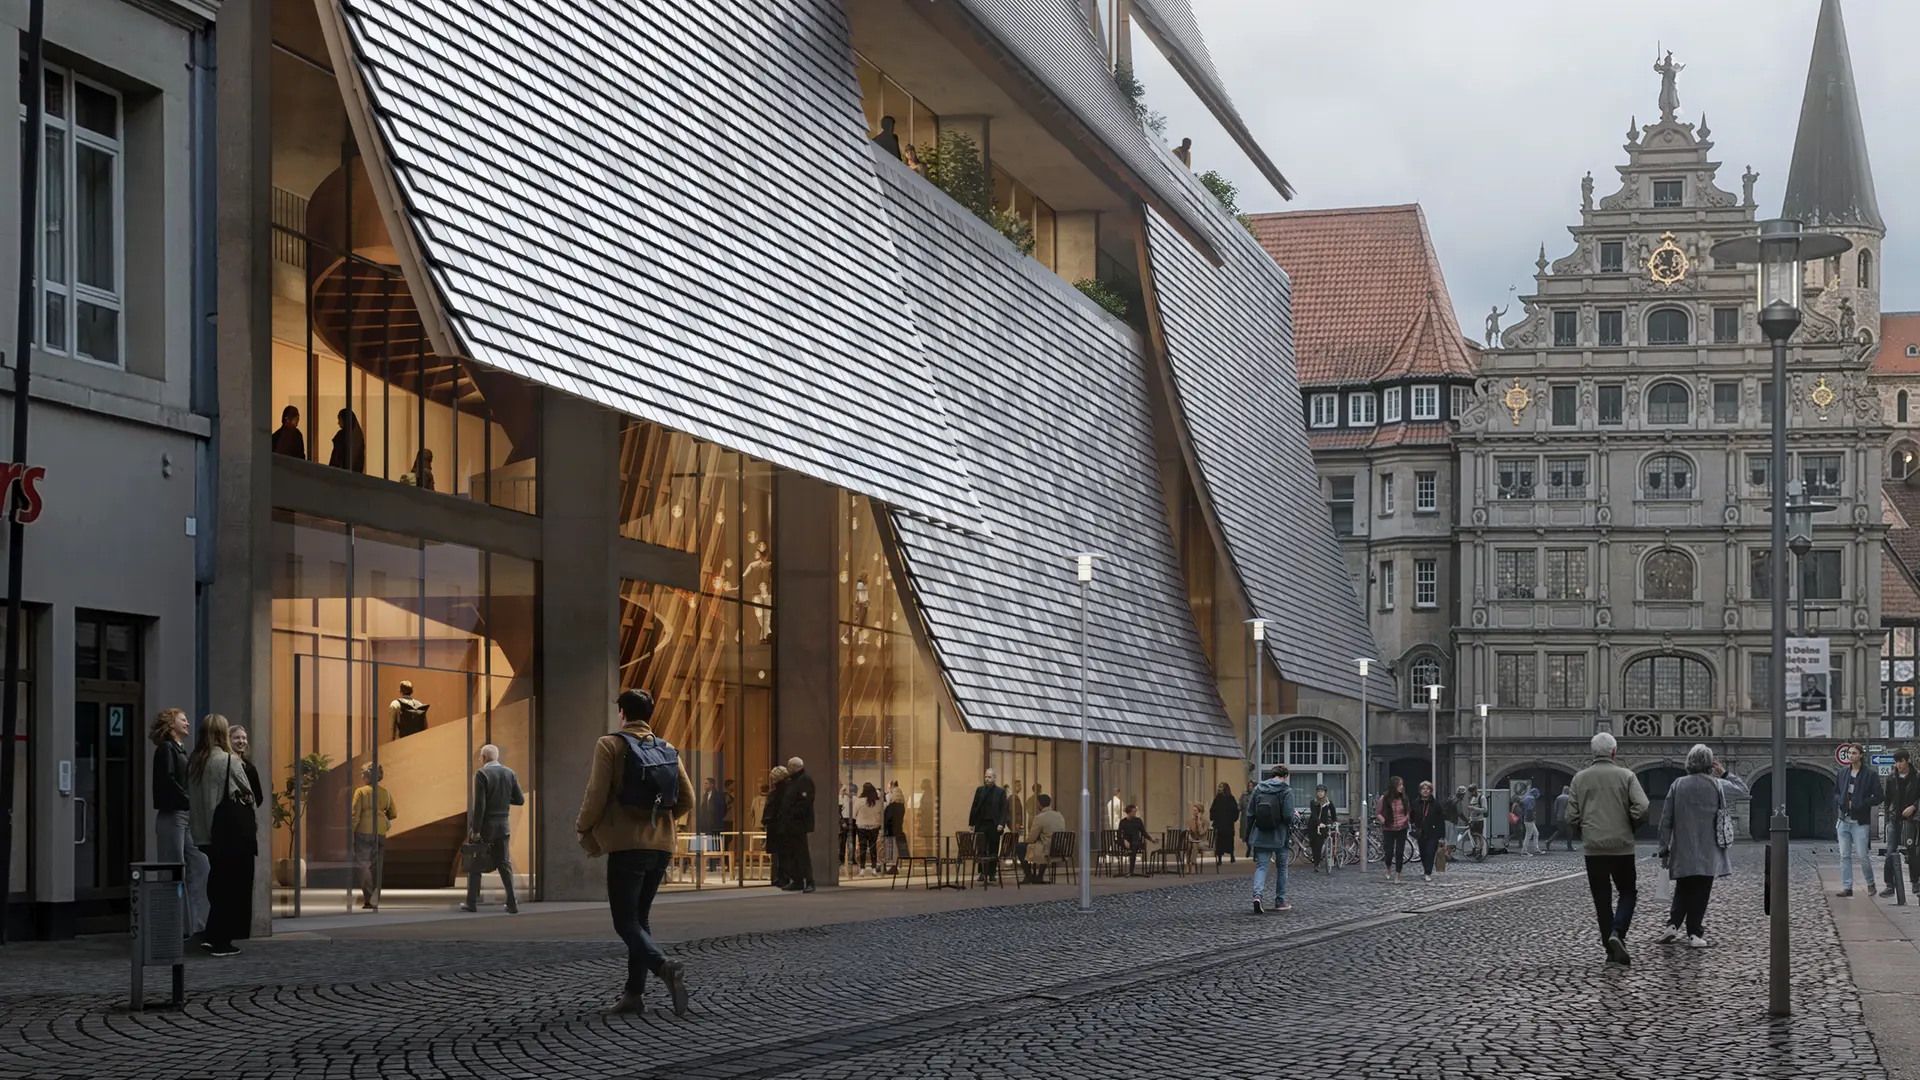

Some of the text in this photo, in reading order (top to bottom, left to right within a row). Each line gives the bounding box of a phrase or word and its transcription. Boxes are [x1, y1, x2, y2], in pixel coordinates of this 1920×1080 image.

[1793, 646, 1820, 654] Deine
[1784, 656, 1807, 664] iete
[111, 709, 122, 733] 2
